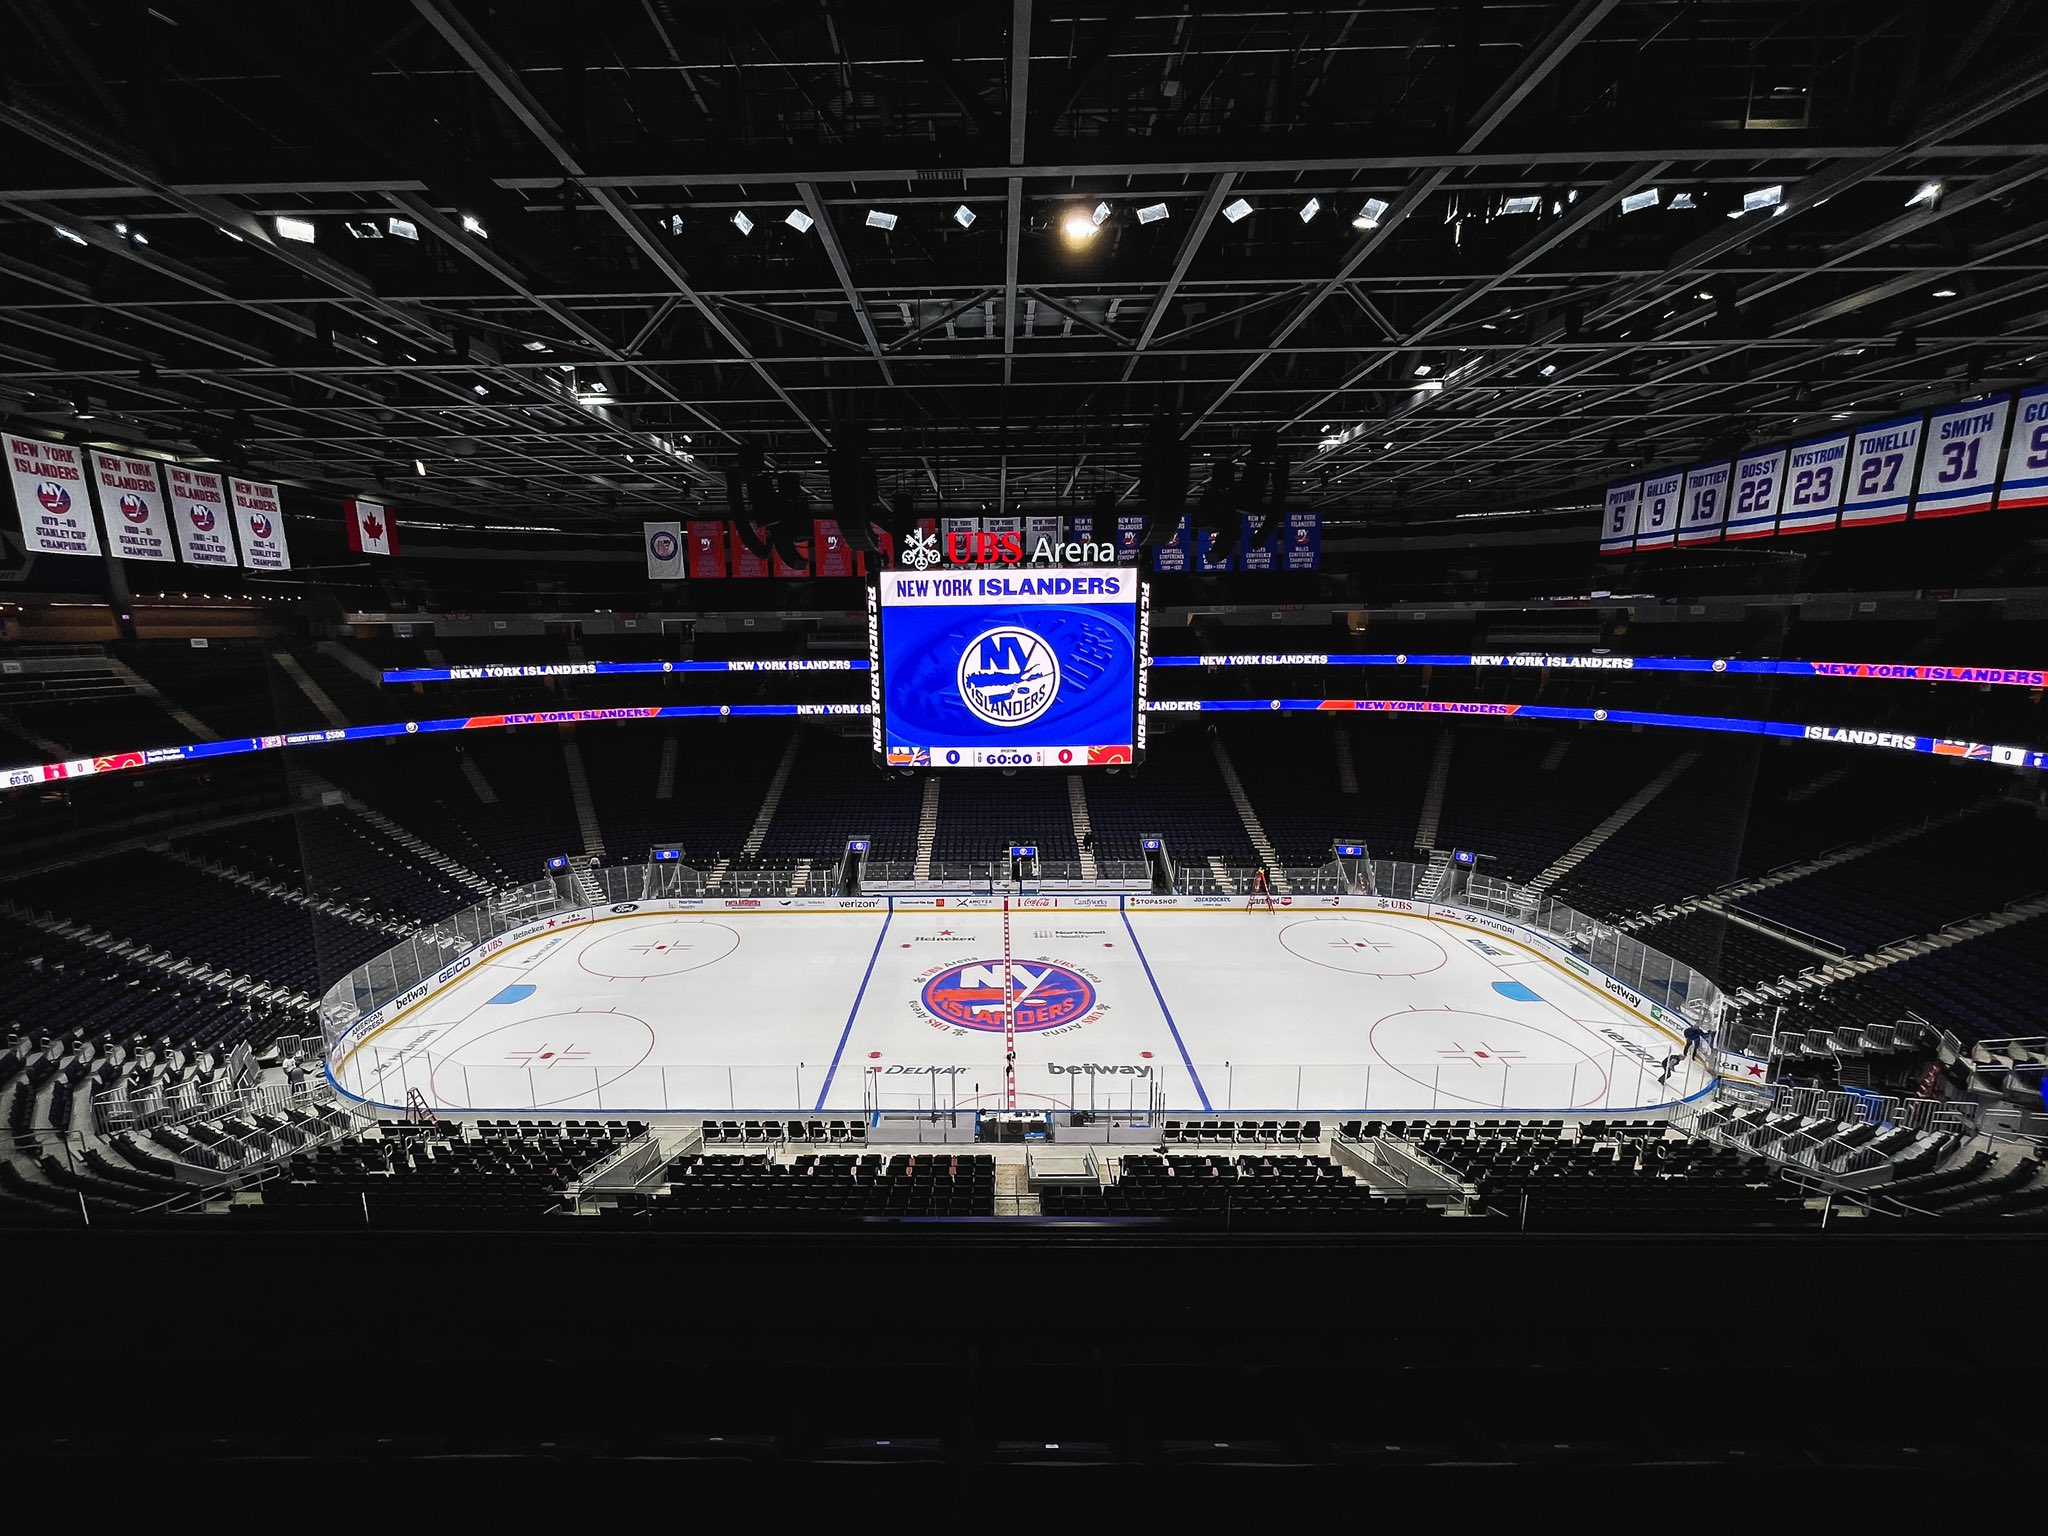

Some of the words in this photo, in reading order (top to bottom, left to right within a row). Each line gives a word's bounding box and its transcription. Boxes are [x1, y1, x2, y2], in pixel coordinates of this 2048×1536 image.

[1940, 412, 1995, 441] SMITH
[12, 439, 39, 457] NEW
[43, 446, 74, 463] YORK
[1859, 429, 1916, 456] TONELLI
[98, 456, 121, 472] NEW
[126, 461, 152, 476] YORK
[1792, 444, 1845, 469] NYSTROM
[1938, 437, 1981, 484] 31
[15, 458, 80, 480] ISLANDERS
[1741, 458, 1778, 479] BOSSY
[1857, 453, 1904, 496] 27
[101, 472, 156, 493] ISLANDERS
[171, 469, 191, 485] NEW
[194, 474, 217, 489] YORK
[1647, 480, 1678, 497] GILLIES
[1689, 470, 1728, 489] TROTTIER
[1793, 466, 1834, 506] 23
[174, 484, 221, 504] ISLANDERS
[234, 481, 251, 496] NEW
[254, 485, 274, 499] YORK
[1609, 488, 1637, 506] POTVIN
[1737, 477, 1774, 514] 22
[236, 495, 278, 512] ISLANDERS
[1652, 498, 1666, 527] 9
[1691, 488, 1717, 521] 19
[1613, 506, 1626, 533] 5
[36, 527, 70, 539] STANLEY
[71, 531, 87, 540] CUP
[119, 535, 148, 546] STANLEY
[148, 538, 162, 547] CUP
[40, 539, 87, 551] CHAMPIONS
[123, 546, 163, 557] CHAMPIONS
[189, 542, 215, 552] STANLEY
[946, 532, 1023, 563] UBS
[1031, 538, 1114, 562] Arena
[193, 552, 227, 563] CHAMPIONS
[897, 580, 929, 597] NEW
[933, 580, 972, 597] YORK
[979, 577, 1120, 596] ISLANDERS
[868, 615, 880, 701] RICHARD
[980, 637, 1038, 671] NY
[1138, 611, 1149, 698] RICHARD
[1199, 656, 1228, 666] NEW
[1229, 656, 1260, 665] YORK
[1261, 655, 1328, 665] ISLANDERS
[1470, 655, 1504, 666] NEW
[1507, 656, 1545, 668] YORK
[1547, 657, 1634, 669] ISLANDERS
[450, 668, 483, 679] NEW
[486, 667, 521, 678] YORK
[523, 665, 596, 678] ISLANDERS
[729, 661, 754, 671] NEW
[757, 660, 785, 671] YORK
[788, 660, 851, 670] ISLANDERS
[1818, 664, 1865, 677] NEW
[1867, 665, 1920, 679] YORK
[1924, 667, 2043, 685] ISLANDERS
[797, 705, 822, 715] NEW
[824, 704, 855, 714] YORK
[871, 701, 880, 714] &
[971, 685, 1046, 717] ISLANDERS
[1138, 700, 1146, 712] &
[1355, 702, 1385, 711] NEW
[1387, 702, 1425, 712] YORK
[1428, 702, 1508, 715] ISLANDERS
[504, 714, 534, 724] NEW
[538, 712, 574, 722] YORK
[577, 708, 650, 720] ISLANDERS
[872, 716, 882, 753] SON
[1137, 714, 1146, 749] SON
[1805, 727, 1916, 750] ISLANDERS
[946, 750, 960, 764] 0
[986, 755, 1033, 765] 60:00
[1058, 749, 1073, 764] 0
[2005, 751, 2011, 760] 0
[77, 763, 84, 773] 0
[9, 774, 35, 785] 60:00
[612, 903, 637, 913] Ford
[839, 899, 875, 908] verizon
[1391, 900, 1413, 910] UBS
[513, 925, 545, 940] Heineken
[1480, 919, 1515, 935] HYUNDAI
[487, 938, 503, 952] UBS
[438, 957, 471, 984] GEICO
[922, 966, 944, 977] UBS
[944, 956, 979, 968] Arena
[1053, 959, 1077, 969] UBS
[1077, 968, 1102, 984] Arena
[960, 965, 1054, 1001] NY
[1605, 977, 1641, 1008] betway
[396, 983, 429, 1010] betway
[908, 1000, 929, 1019] Arena
[1081, 1011, 1105, 1025] UBS
[352, 1010, 383, 1037] AMERICAN
[356, 1017, 385, 1041] EXPRESS
[924, 1018, 951, 1032] UBS
[1042, 1022, 1082, 1038] Arena
[388, 1029, 438, 1061] HYUNDAI
[1600, 1028, 1663, 1068] verizon
[1048, 1063, 1151, 1078] betway
